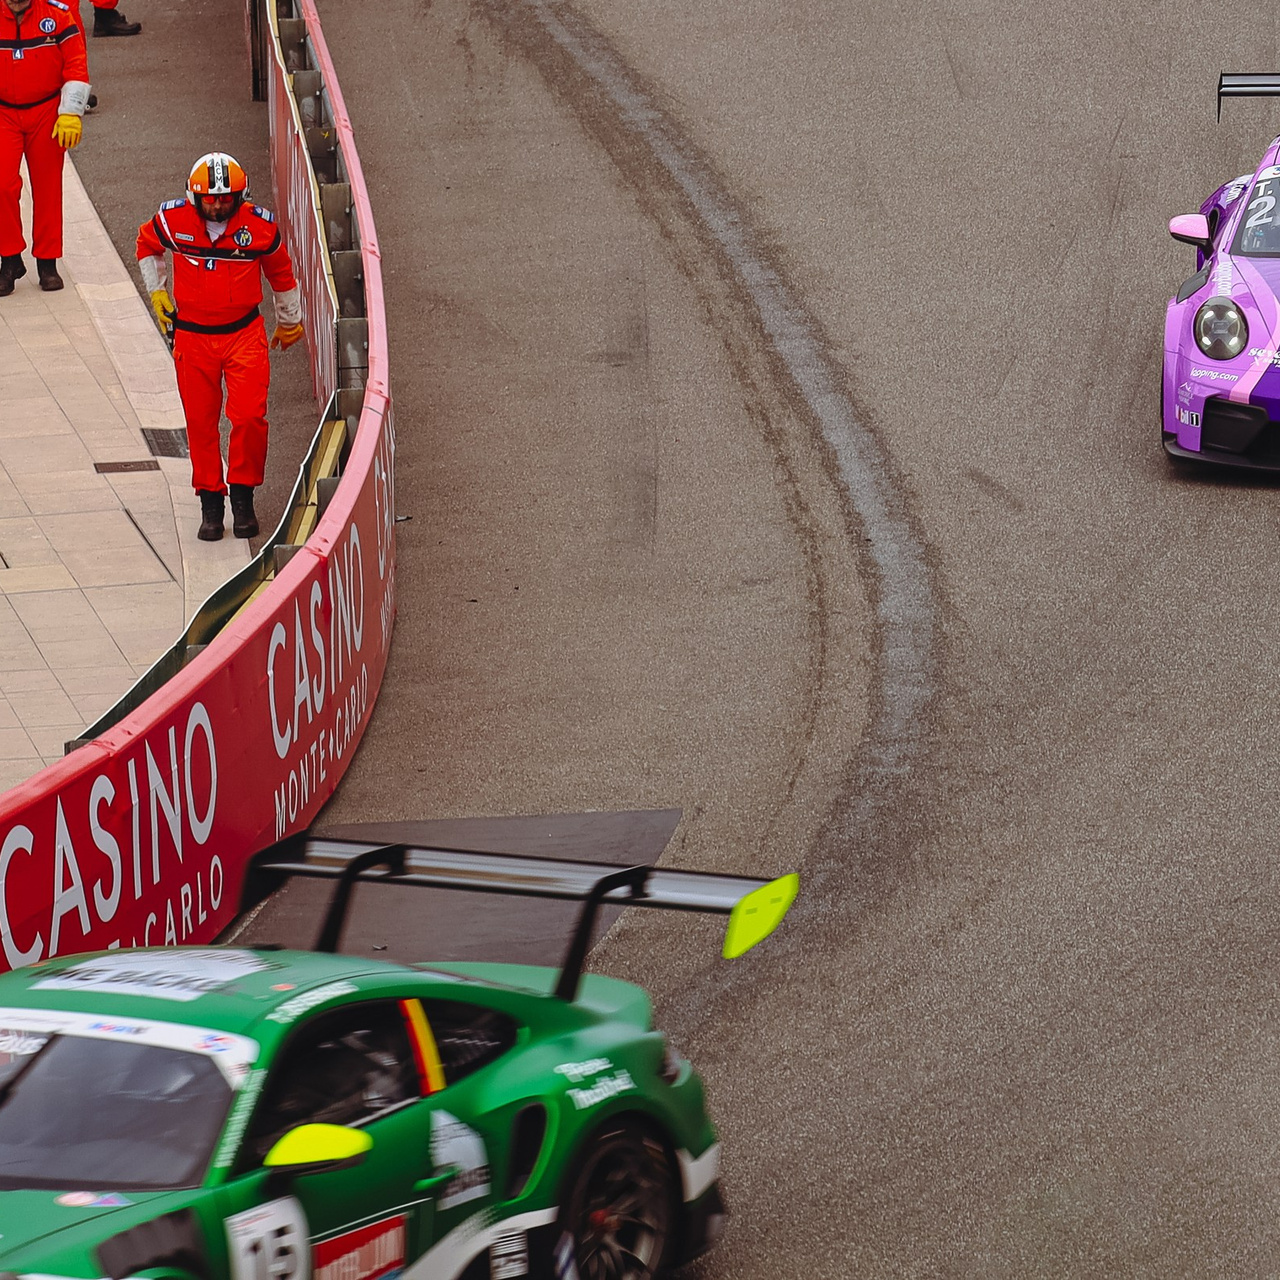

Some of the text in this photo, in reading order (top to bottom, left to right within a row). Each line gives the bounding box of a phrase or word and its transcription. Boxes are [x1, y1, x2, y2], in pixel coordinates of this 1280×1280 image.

[215, 161, 223, 184] ACM
[1256, 181, 1273, 197] T.
[207, 260, 213, 270] 4
[1190, 368, 1238, 382] looping.com
[267, 522, 364, 759] CASINO
[335, 662, 369, 761] CARLO
[0, 702, 219, 972] CASINO
